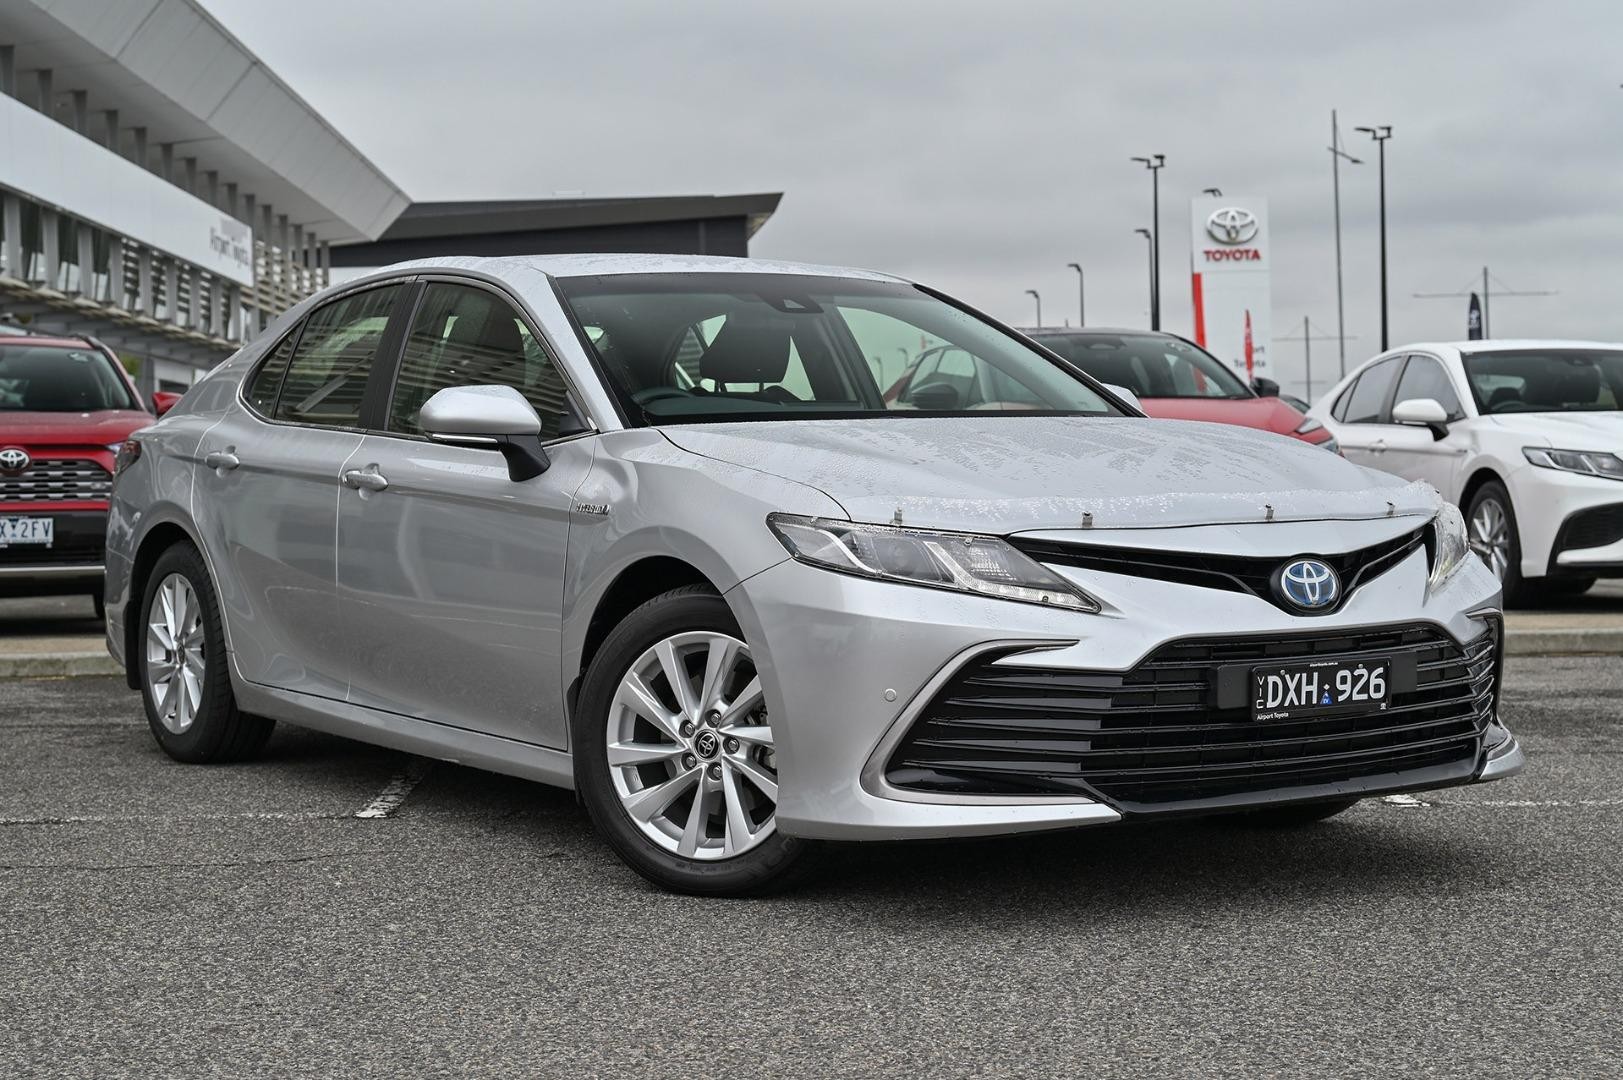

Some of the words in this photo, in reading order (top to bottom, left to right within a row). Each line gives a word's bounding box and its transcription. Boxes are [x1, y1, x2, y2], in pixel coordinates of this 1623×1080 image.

[1203, 249, 1261, 262] TOYOTA
[20, 521, 51, 538] 2FV
[1266, 671, 1319, 709] DXH
[1335, 666, 1386, 702] 926
[1256, 712, 1274, 721] Airport
[1274, 711, 1289, 720] Toyota
